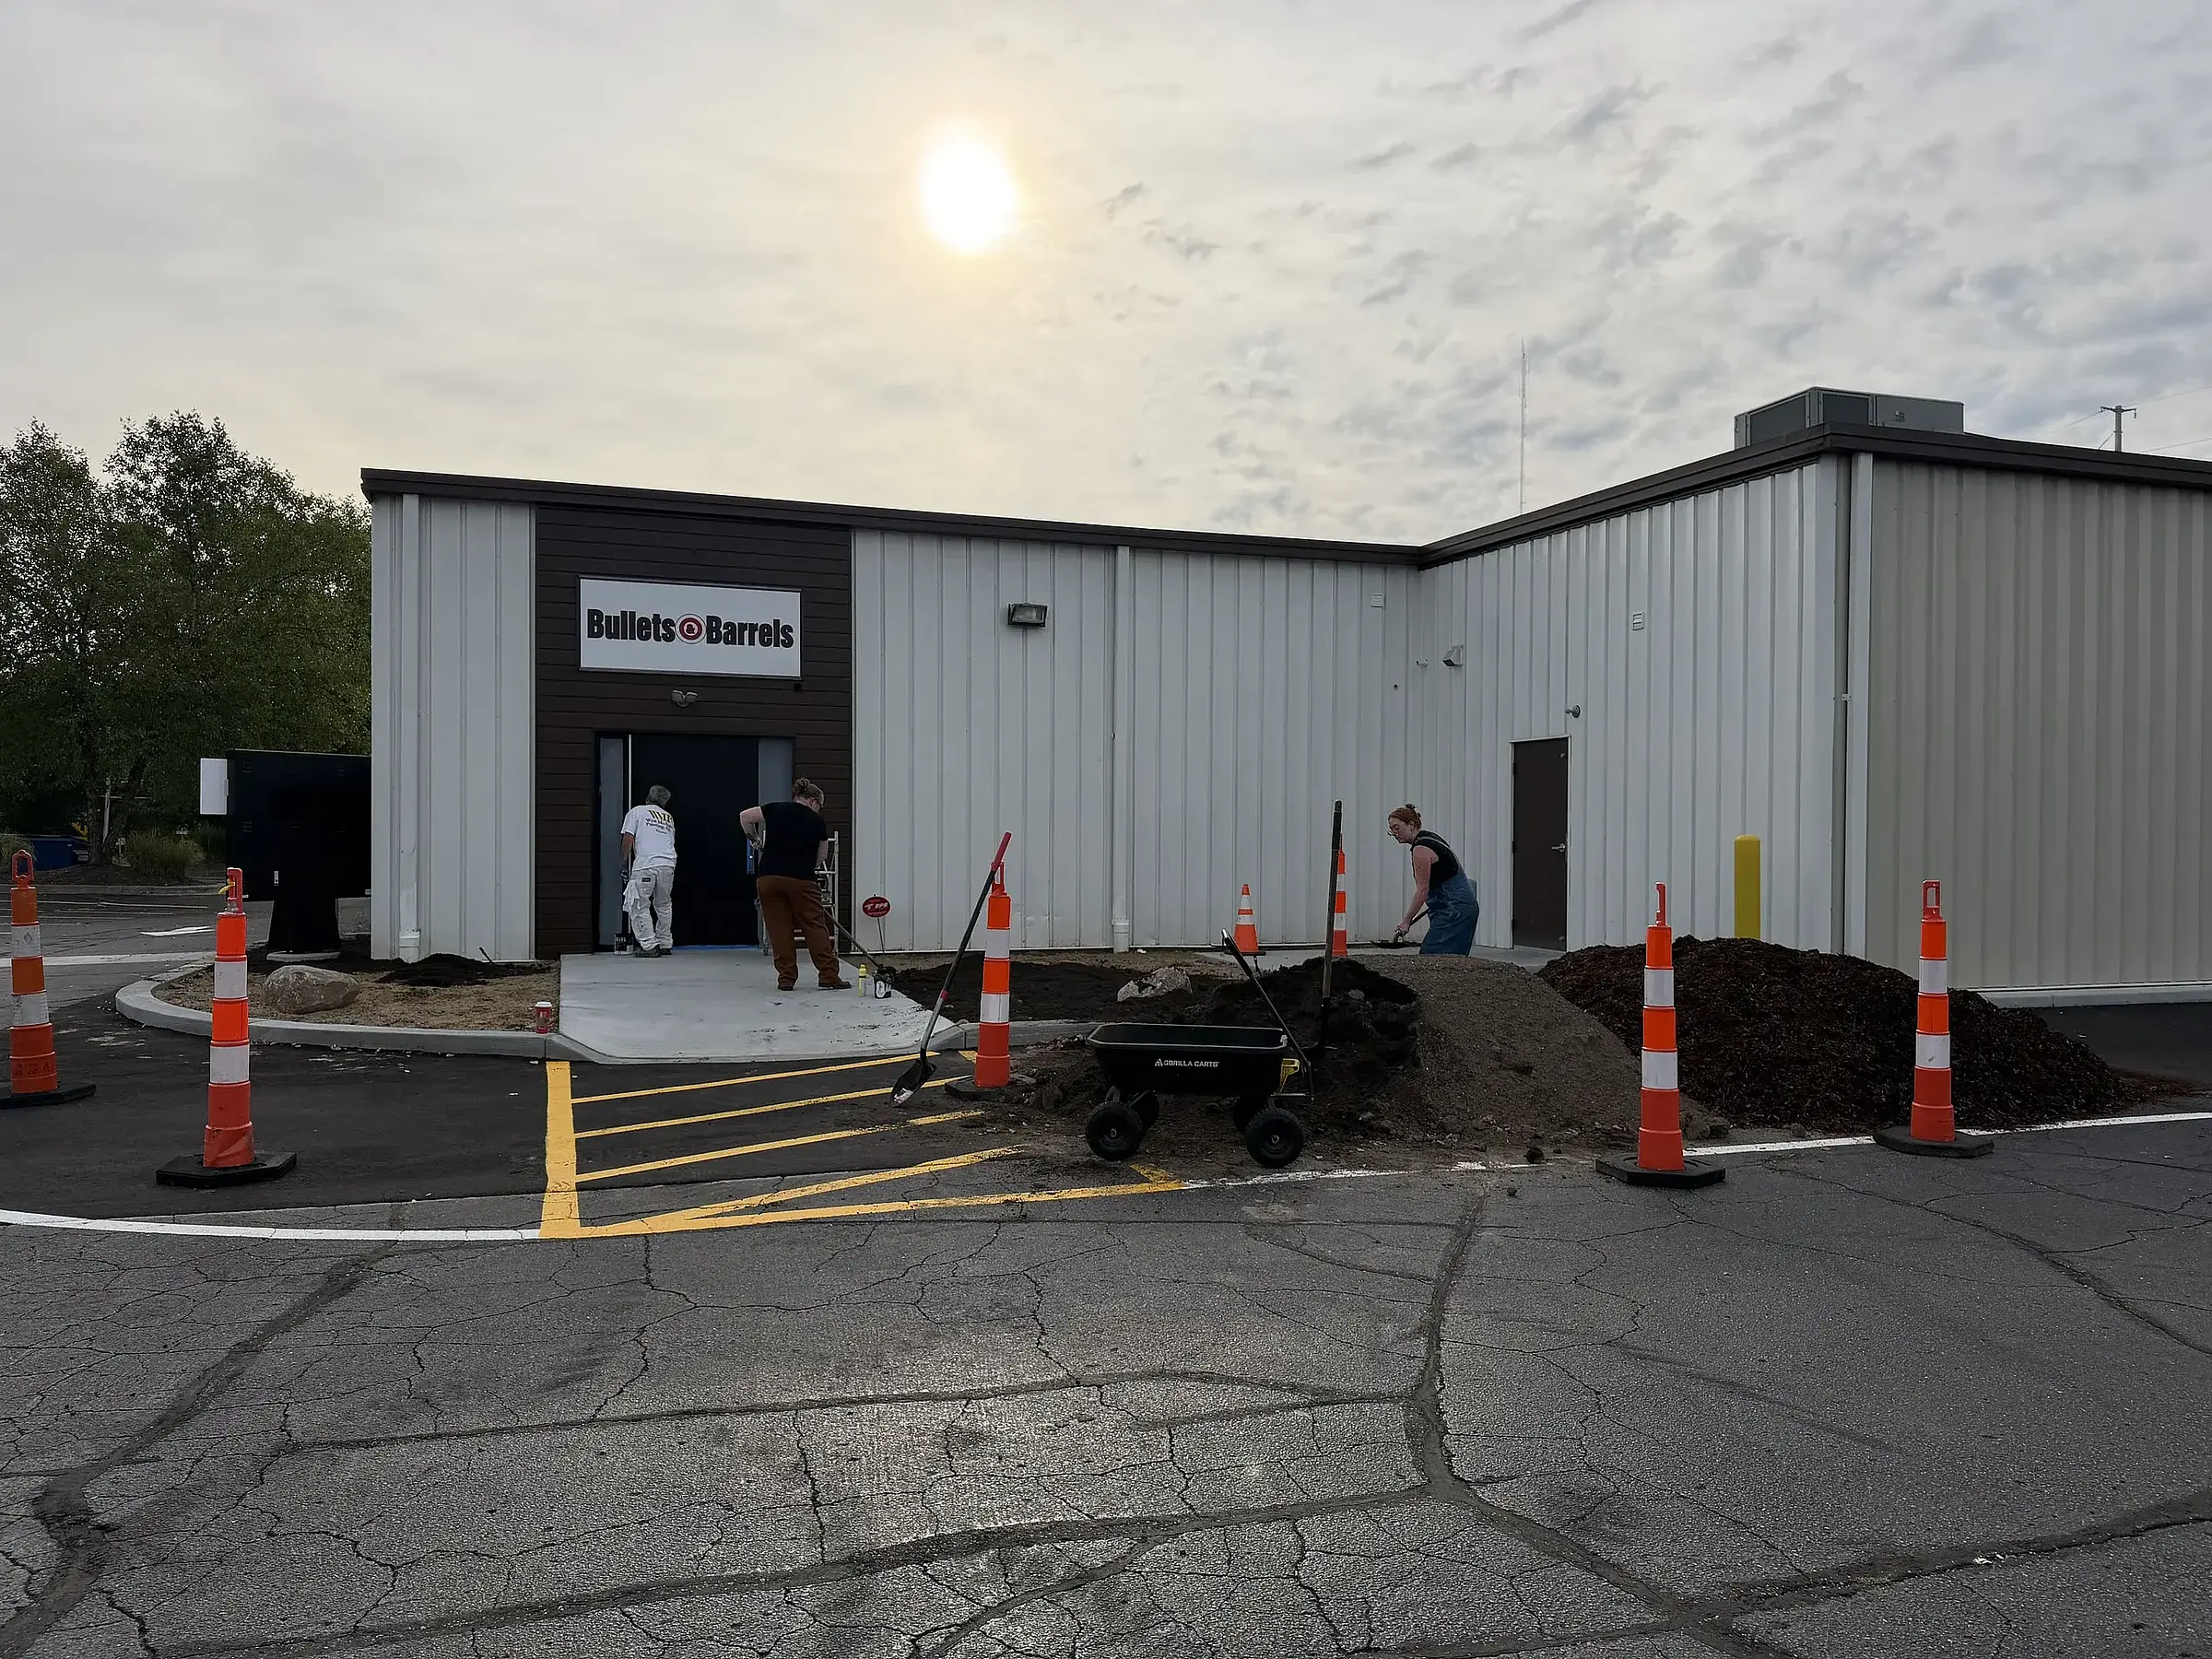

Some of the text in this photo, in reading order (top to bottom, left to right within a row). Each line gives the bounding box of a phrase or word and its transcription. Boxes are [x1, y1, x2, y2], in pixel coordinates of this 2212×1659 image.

[587, 608, 677, 643] Bullets
[706, 615, 794, 649] Barrels
[1163, 1059, 1194, 1067] GORILLA
